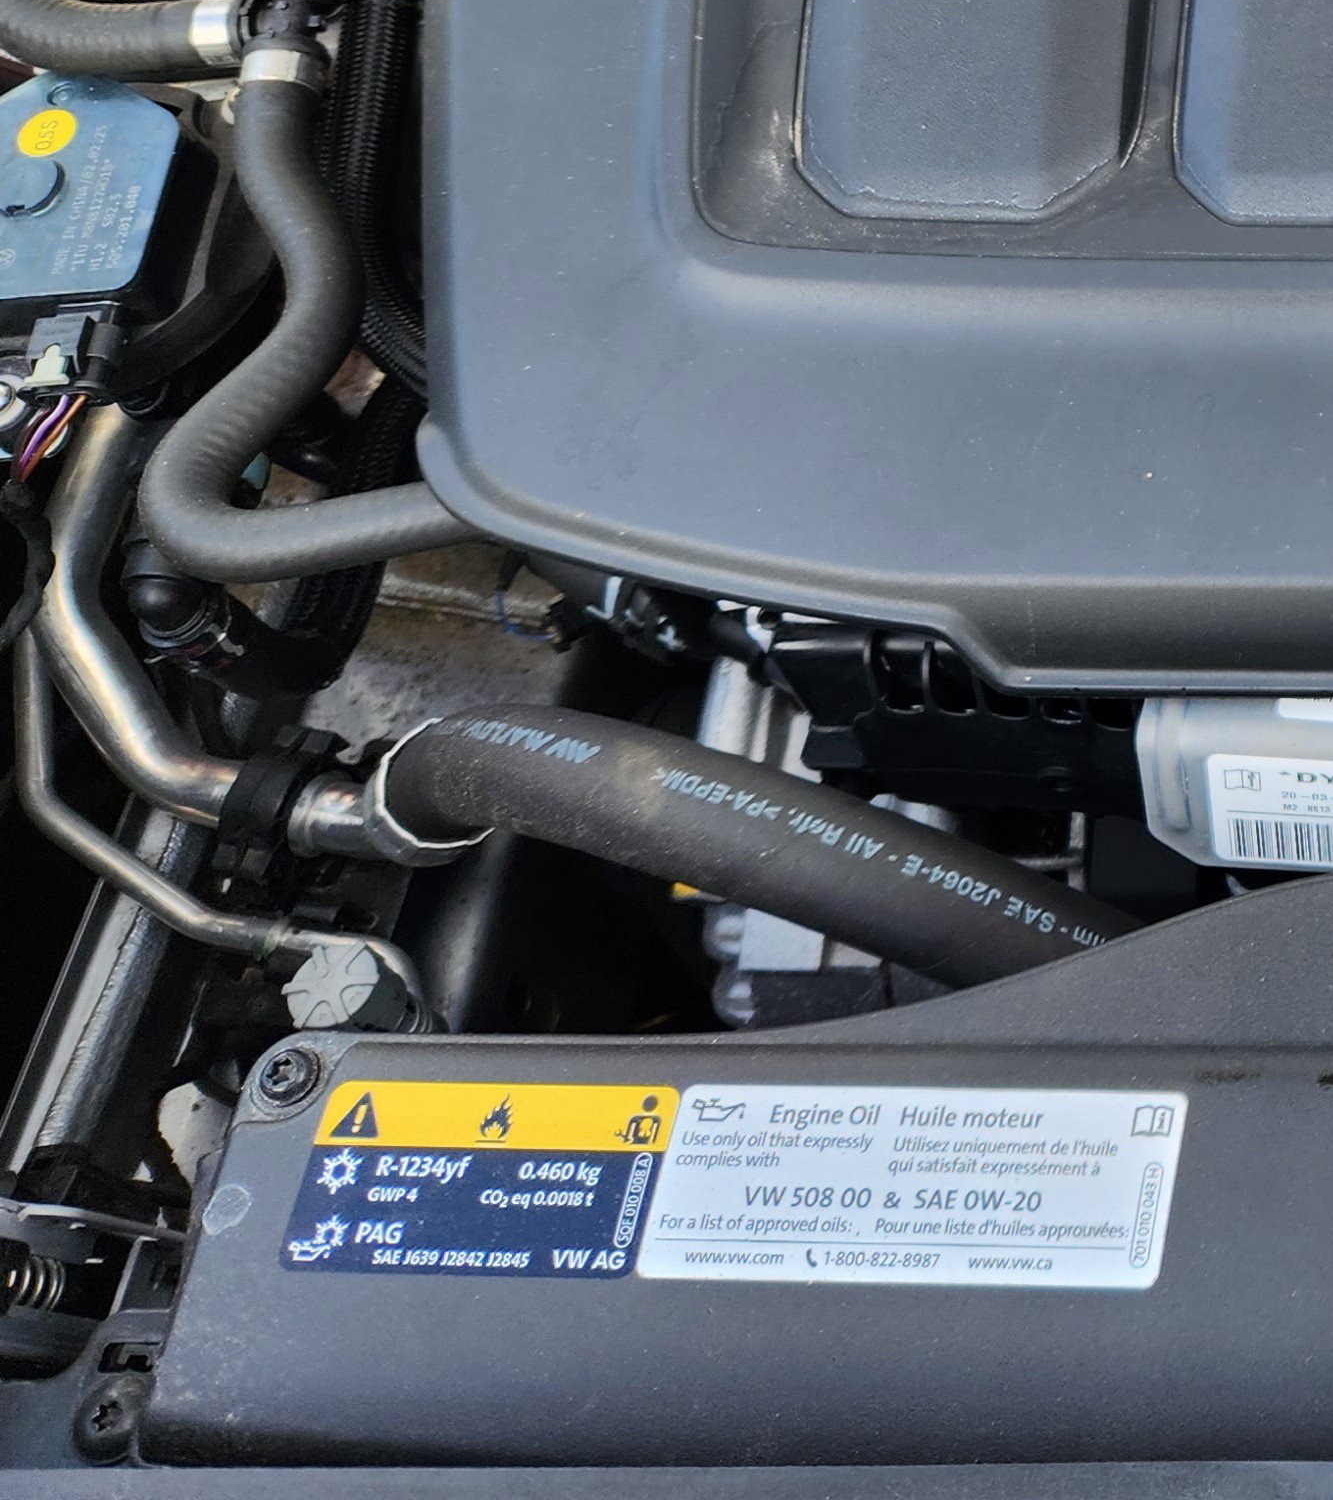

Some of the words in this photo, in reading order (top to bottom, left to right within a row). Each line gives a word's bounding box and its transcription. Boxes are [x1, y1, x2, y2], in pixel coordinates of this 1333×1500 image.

[650, 765, 785, 821] >PA-EPDM<
[843, 831, 886, 860] All
[901, 853, 1002, 906] J2064-E
[1003, 895, 1058, 934] SAE
[769, 1104, 843, 1130] Engine
[849, 1104, 881, 1126] Oil
[899, 1106, 957, 1128] Huile
[962, 1111, 1044, 1129] moteur
[682, 1130, 711, 1146] Use
[713, 1132, 746, 1151] only
[748, 1132, 768, 1148] oil
[769, 1133, 801, 1149] that
[803, 1134, 874, 1153] expressly
[892, 1136, 950, 1152] Utilisez
[953, 1138, 1046, 1157] uniquement
[1049, 1140, 1069, 1156] de
[1071, 1140, 1119, 1157] l'huile
[375, 1153, 474, 1185] R-1234yf
[518, 1161, 574, 1182] 0.460
[577, 1161, 603, 1186] kg
[675, 1152, 743, 1171] complies
[746, 1153, 780, 1167] with
[888, 1157, 914, 1176] qui
[916, 1156, 977, 1174] satisfait
[980, 1160, 1087, 1179] expressément
[1090, 1162, 1101, 1177] à
[630, 1169, 646, 1195] 008
[367, 1187, 406, 1202] GWP
[407, 1188, 419, 1202] 4
[511, 1192, 531, 1211] eq
[533, 1190, 583, 1207] 0.0018
[585, 1192, 595, 1207] t
[745, 1185, 787, 1207] VW
[790, 1187, 836, 1208] 508
[840, 1187, 872, 1209] 00
[882, 1190, 901, 1209] &
[913, 1188, 958, 1210] SAE
[963, 1189, 1043, 1212] 0W-20
[623, 1195, 639, 1219] 010
[354, 1222, 404, 1245] PAG
[659, 1214, 686, 1230] For
[687, 1218, 696, 1230] a
[700, 1215, 723, 1230] list
[726, 1215, 744, 1231] of
[745, 1216, 819, 1235] approved
[821, 1217, 852, 1233] oils:
[874, 1218, 910, 1235] Pour
[913, 1221, 942, 1235] une
[944, 1217, 975, 1235] liste
[977, 1218, 1036, 1236] d'huiles
[1038, 1220, 1131, 1241] approuvées:
[1137, 1211, 1152, 1237] 010
[371, 1249, 402, 1265] SAE
[402, 1250, 438, 1266] J639
[440, 1250, 484, 1268] J2842
[486, 1251, 531, 1269] J2845
[552, 1249, 592, 1270] VW
[593, 1250, 627, 1271] AG
[685, 1250, 785, 1265] www.vw.com
[824, 1251, 942, 1269] 1-800-822-8987
[968, 1255, 1053, 1271] www.vw.ca
